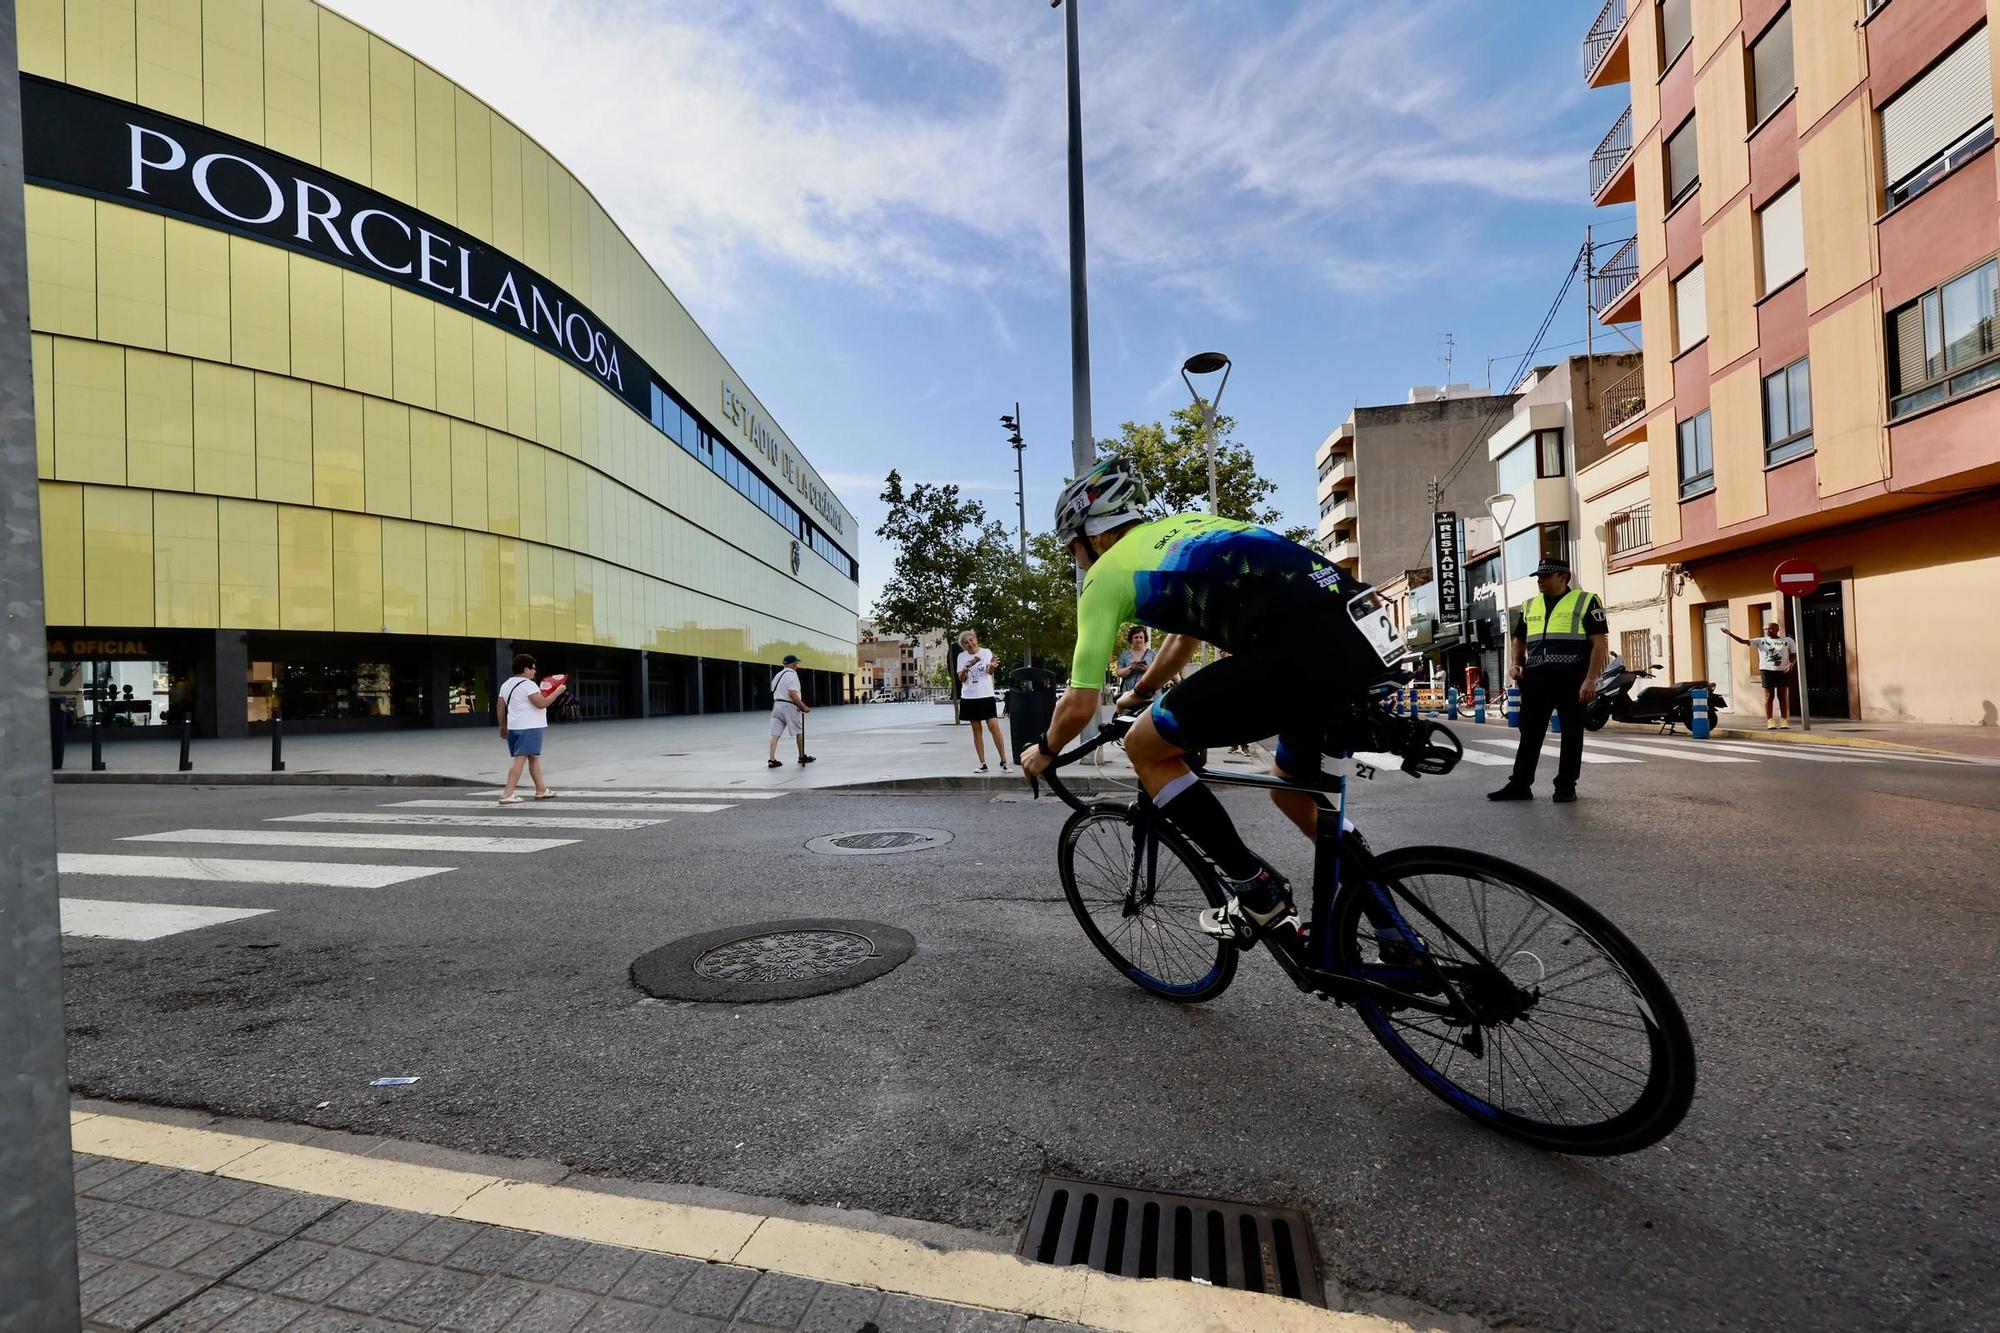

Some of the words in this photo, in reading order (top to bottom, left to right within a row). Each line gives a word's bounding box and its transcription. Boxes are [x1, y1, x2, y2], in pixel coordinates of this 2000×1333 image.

[126, 122, 624, 392] PORCELANOSA
[720, 378, 778, 467] ESTADIO
[781, 448, 794, 485] DE
[797, 466, 809, 500] LA
[1154, 528, 1181, 550] SKLZ
[1308, 565, 1336, 581] TEAM
[1440, 524, 1456, 611] RESTAURANTE
[1316, 573, 1341, 588] ZOOT
[72, 640, 148, 655] OFICIAL
[1356, 763, 1376, 780] 27
